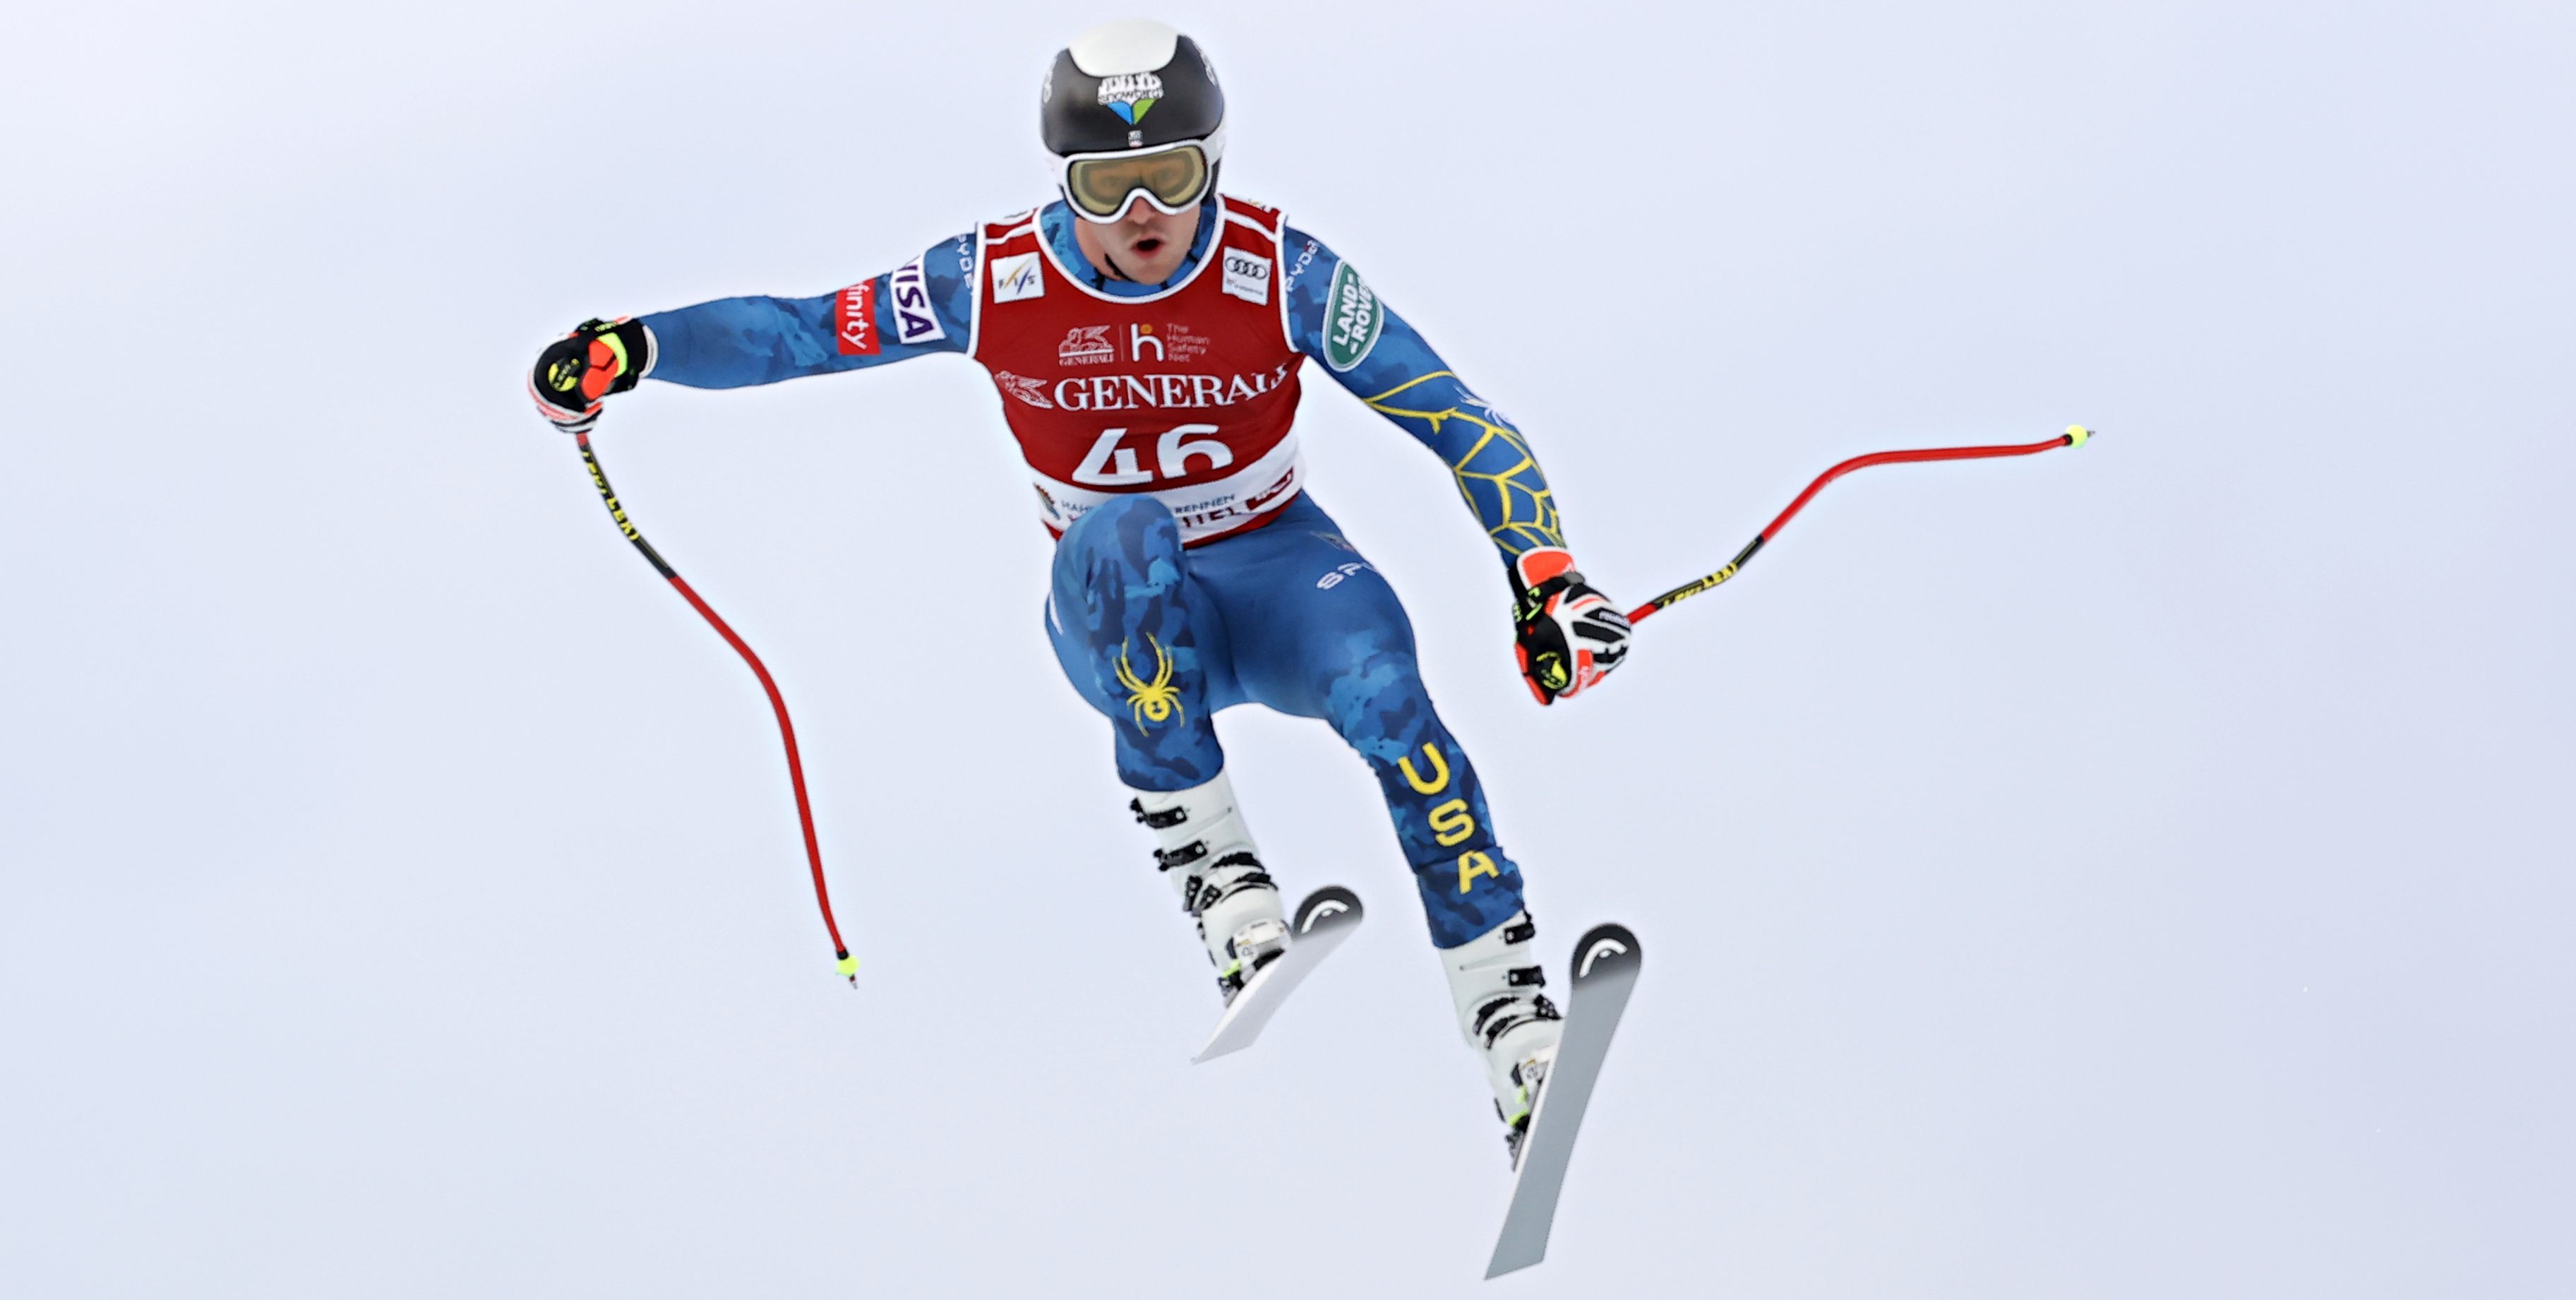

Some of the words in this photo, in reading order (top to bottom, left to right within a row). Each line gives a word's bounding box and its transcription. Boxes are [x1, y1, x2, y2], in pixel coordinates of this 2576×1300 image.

[1332, 284, 1358, 347] LAND
[1167, 323, 1190, 333] The
[1167, 334, 1211, 345] Human
[1168, 342, 1208, 356] Safety
[1059, 353, 1114, 367] GENERALI
[1168, 353, 1190, 362] Net
[1072, 424, 1233, 485] 46
[1397, 741, 1501, 895] USA
